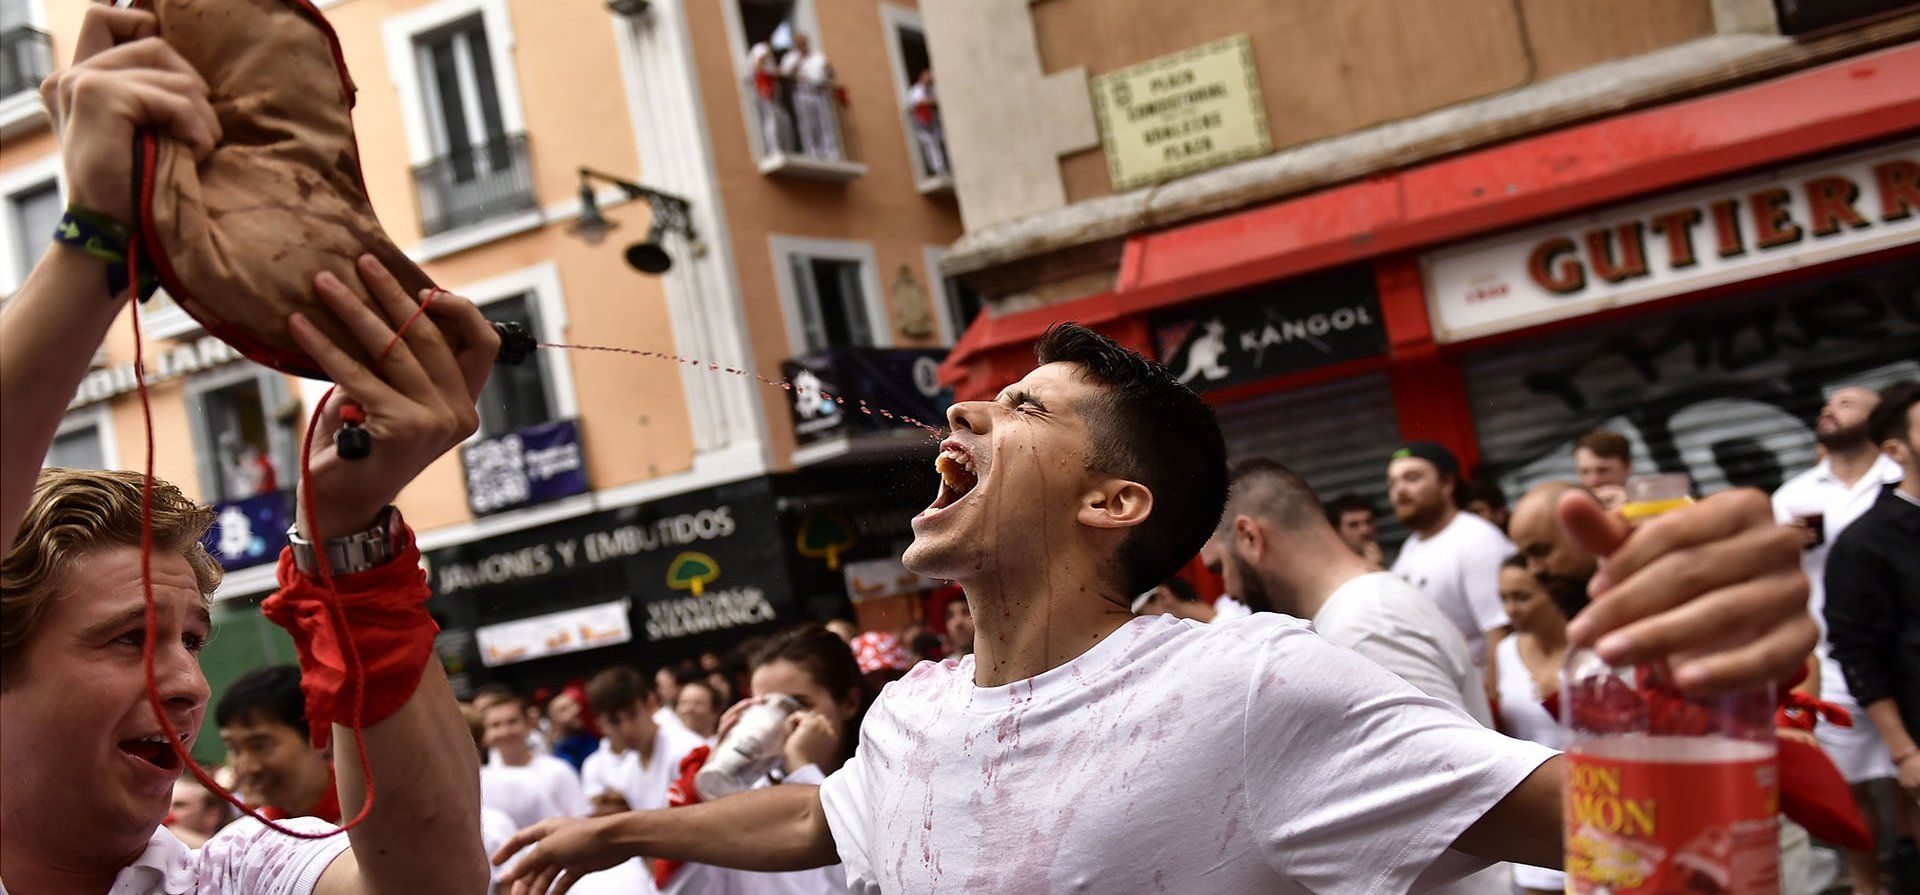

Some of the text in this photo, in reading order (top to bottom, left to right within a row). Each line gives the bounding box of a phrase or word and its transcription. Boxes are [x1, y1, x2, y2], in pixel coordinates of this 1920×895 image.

[1239, 305, 1374, 351] KANGOL
[438, 505, 736, 596] JAMONES Y EMBUTIDOS
